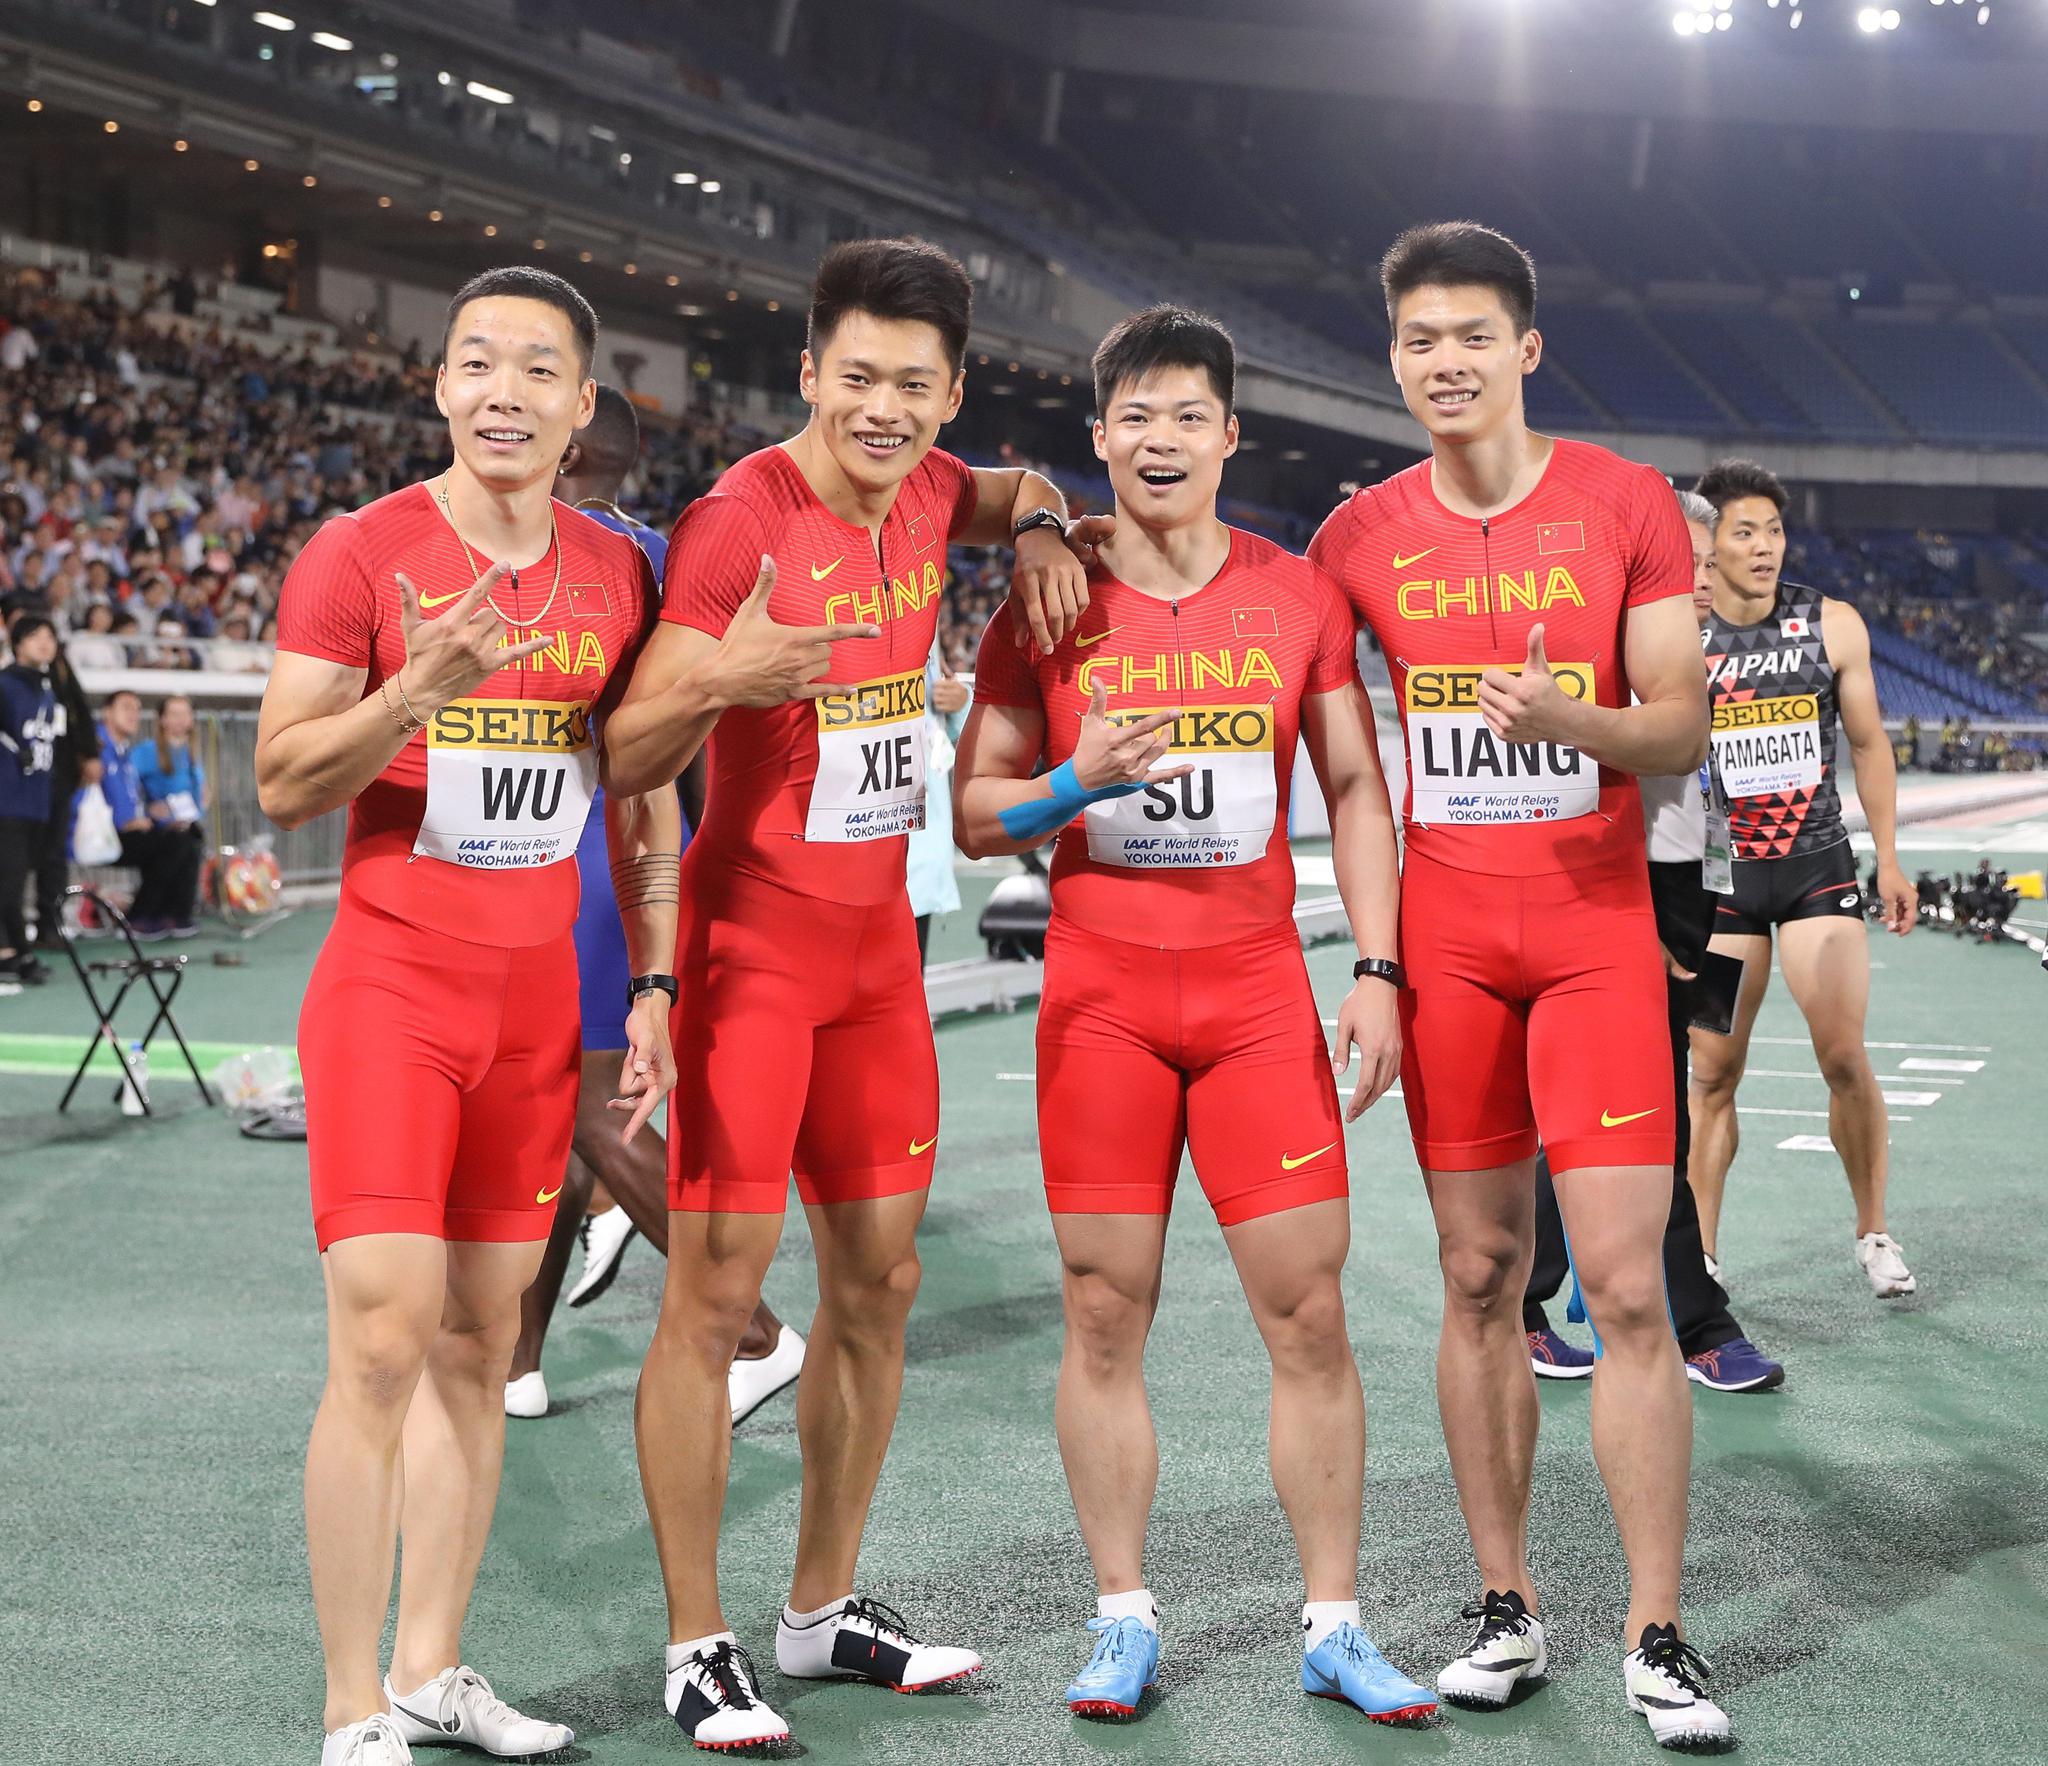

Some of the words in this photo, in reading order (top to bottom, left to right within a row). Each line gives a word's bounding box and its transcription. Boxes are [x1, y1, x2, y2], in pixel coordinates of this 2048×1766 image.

[825, 559, 942, 625] CHINA
[1397, 566, 1586, 620] CHINA
[496, 628, 606, 677] INA
[1706, 648, 1803, 685] JAPAN
[1078, 648, 1283, 696] CHINA
[822, 677, 925, 726] SEIKO
[1711, 699, 1814, 729] SEIKO
[435, 706, 586, 747] SEIKO
[1105, 711, 1267, 747] IKO
[857, 735, 913, 795] XIE
[1422, 727, 1581, 777] LIANG
[1712, 731, 1816, 770] YAMAGATA
[482, 766, 566, 821] WU
[1143, 769, 1214, 821] SU
[1448, 796, 1480, 806] IAAF
[1485, 796, 1519, 806] World
[1521, 795, 1559, 807] Relays
[845, 811, 875, 824] IAAF
[876, 806, 899, 820] World
[900, 804, 923, 816] Relays
[845, 821, 900, 838] YOKOHAMA
[1448, 810, 1521, 820] YOKOHAMA
[457, 853, 529, 866] YOKOHAMA
[458, 840, 497, 851] IAAF
[500, 840, 532, 851] World
[532, 838, 560, 850] Relays
[1123, 839, 1161, 850] IAAF
[1164, 839, 1199, 849] World
[1201, 837, 1239, 849] Relays
[1124, 853, 1201, 864] YOKOHAMA
